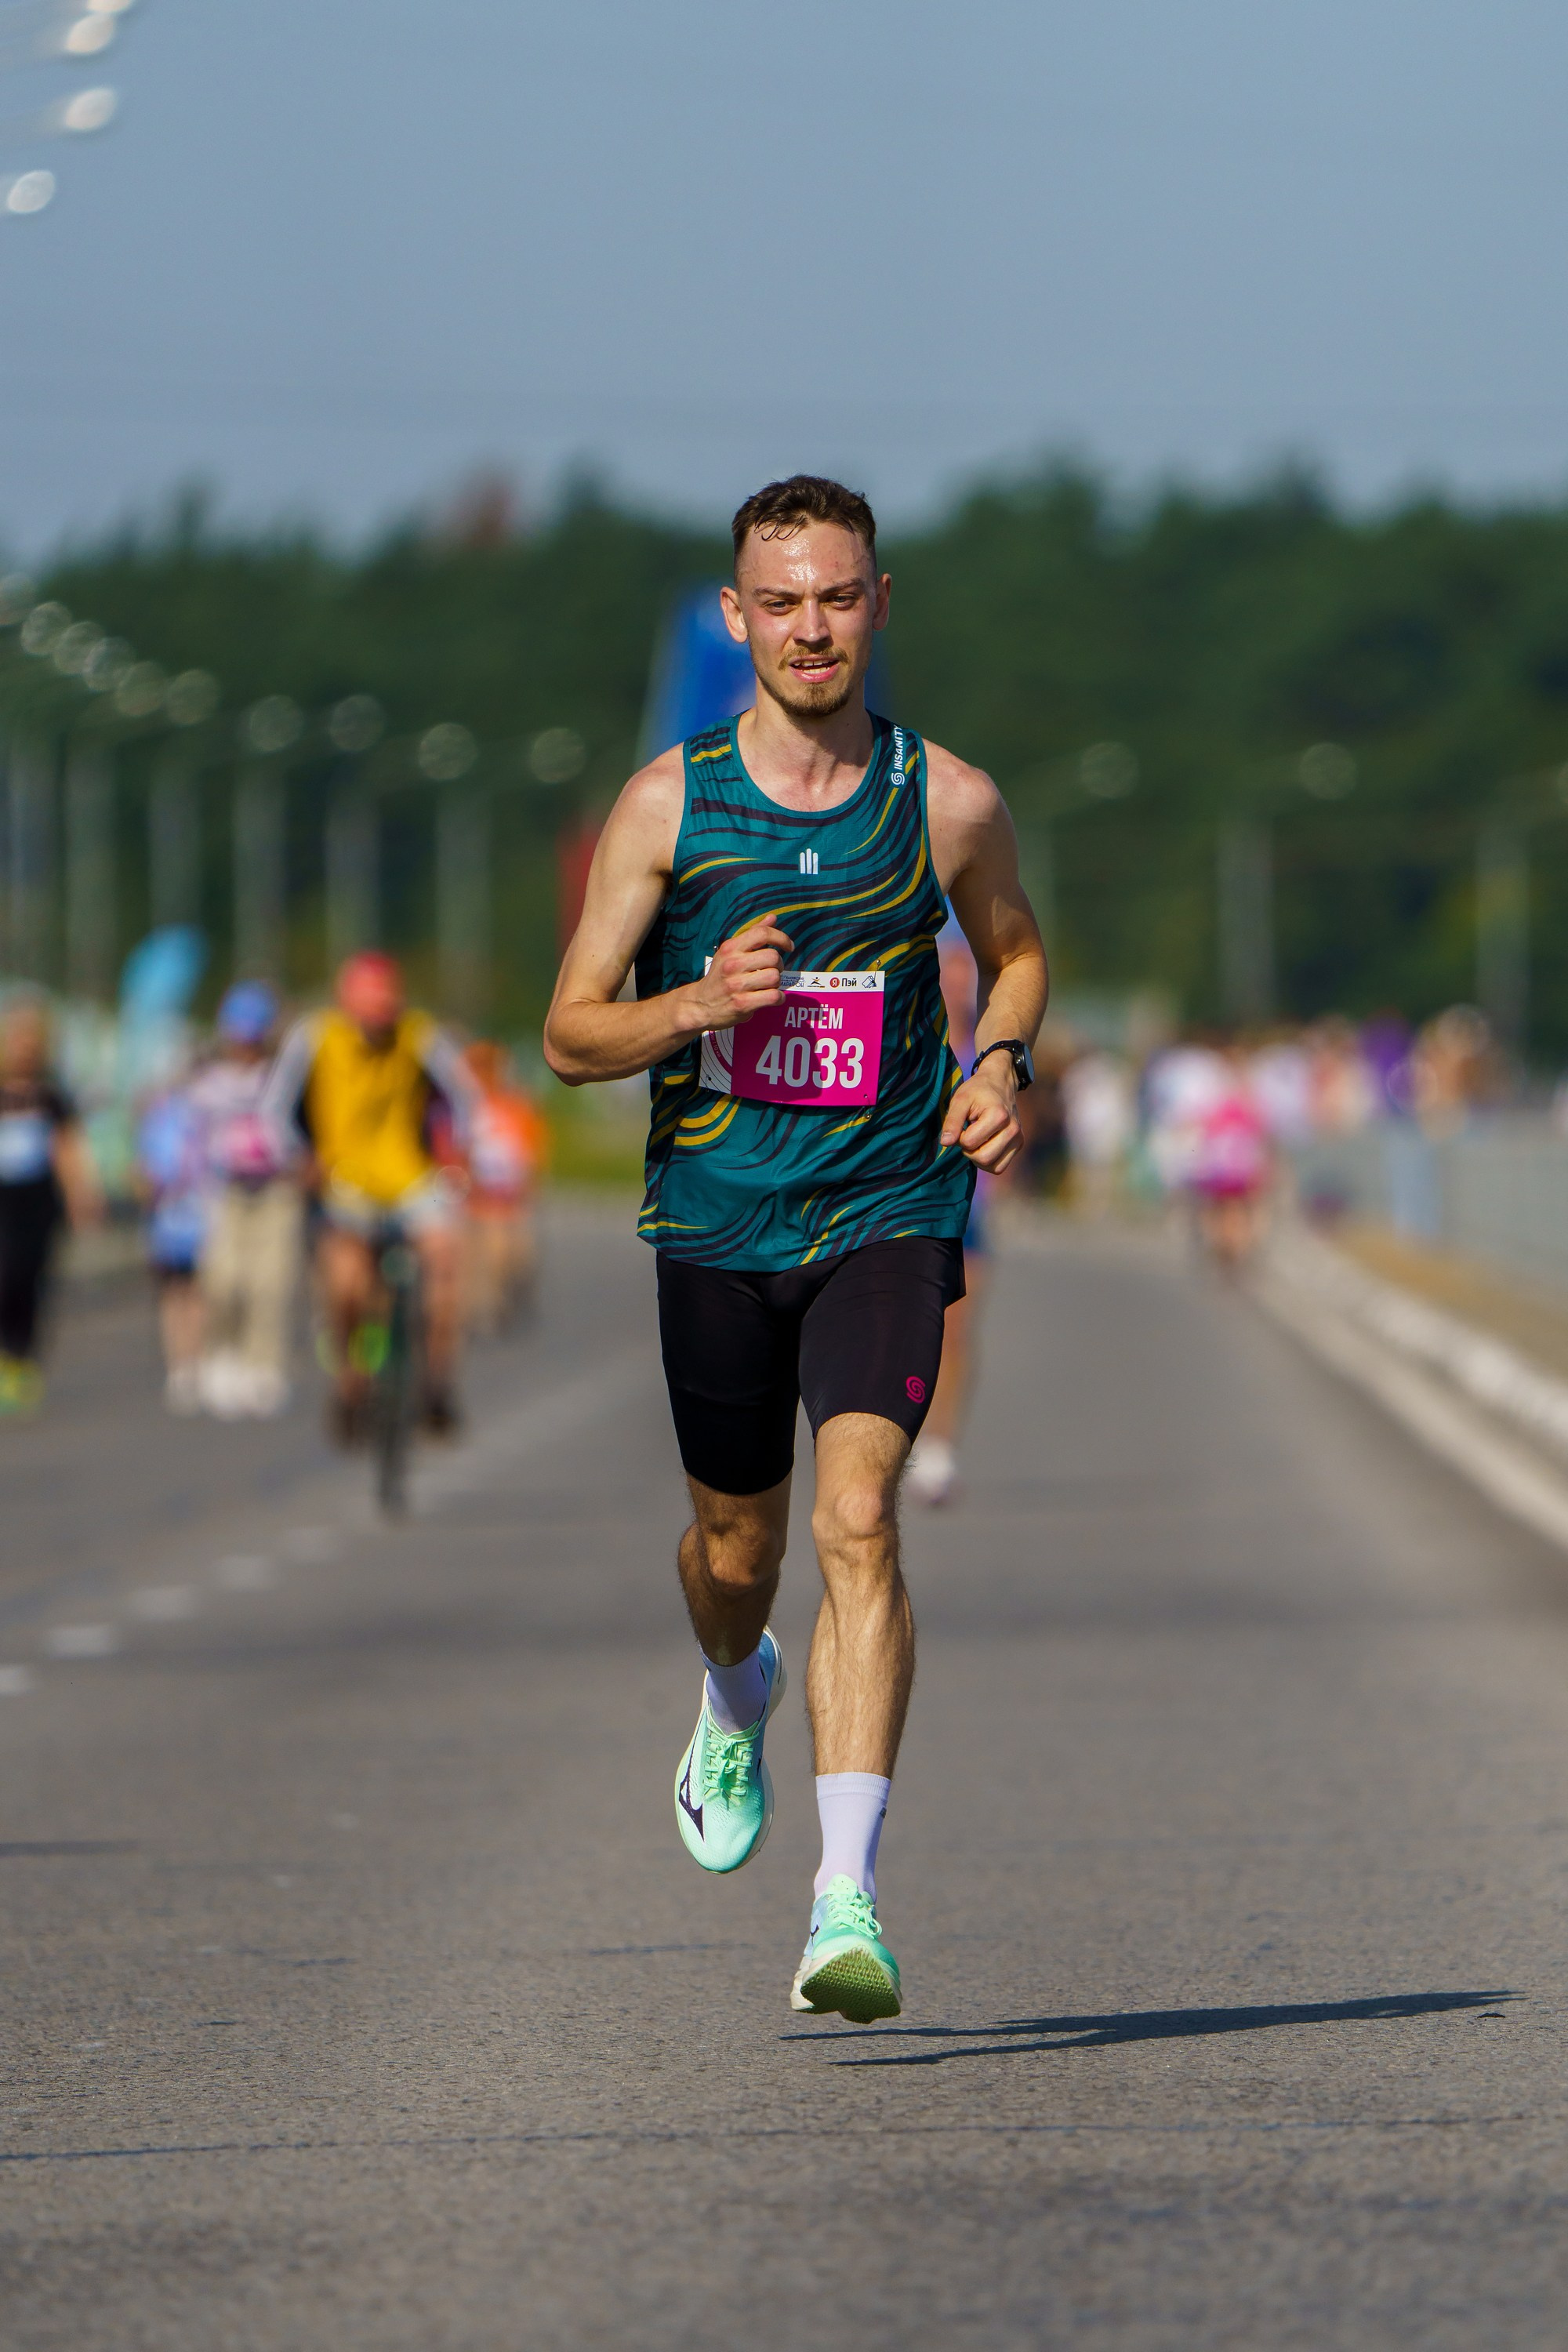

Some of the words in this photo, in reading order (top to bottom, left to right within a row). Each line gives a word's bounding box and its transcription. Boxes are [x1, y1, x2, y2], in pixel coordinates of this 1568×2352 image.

[894, 724, 903, 770] INSANITY
[841, 978, 857, 987] Пэй
[784, 1004, 844, 1029] АРТЁМ
[755, 1035, 864, 1089] 4033
